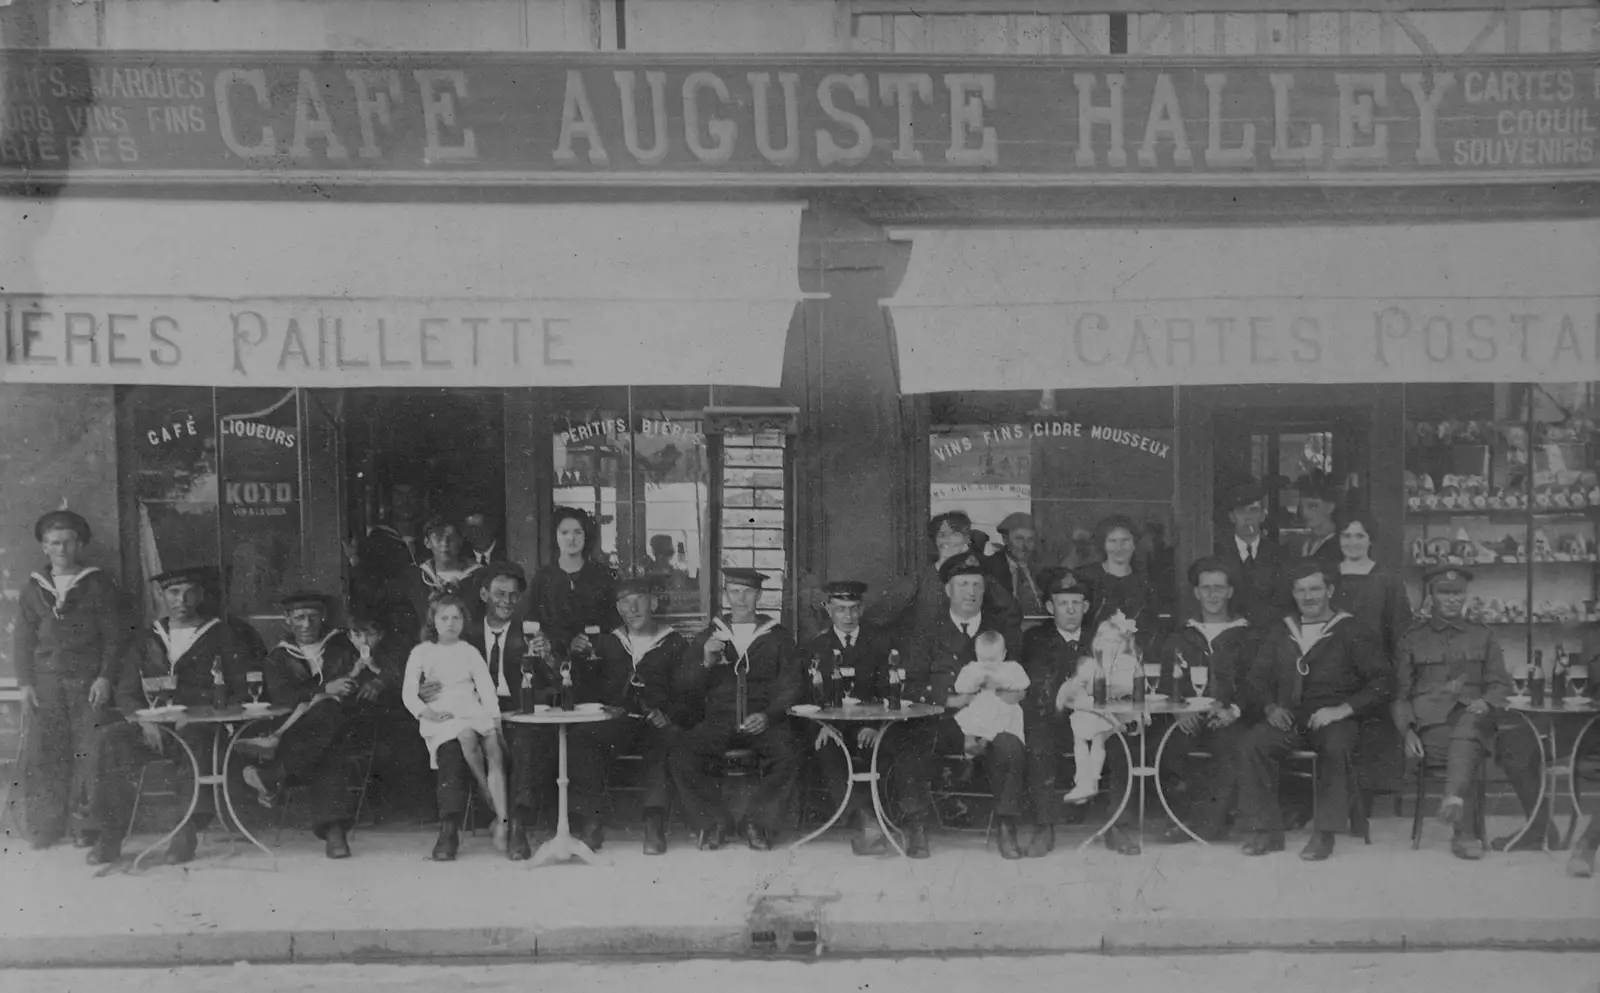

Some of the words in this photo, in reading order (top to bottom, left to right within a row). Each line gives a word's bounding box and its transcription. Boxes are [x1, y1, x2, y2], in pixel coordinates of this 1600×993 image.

[92, 68, 206, 100] MARQUES
[1464, 70, 1576, 103] CARTES
[66, 104, 129, 134] VINS
[147, 104, 206, 134] FINS
[213, 67, 477, 164] CAFE
[552, 69, 999, 167] AUGUSTE
[1072, 72, 1457, 168] HALLEY
[1497, 107, 1598, 135] COQUIL
[1453, 137, 1595, 166] SOUVENIRS
[229, 309, 574, 376] PAILLETTE
[1072, 311, 1322, 368] CARTES
[147, 414, 197, 446] CAFÉ
[219, 419, 297, 449] LIQUEURS
[933, 435, 973, 462] VINS
[983, 424, 1024, 446] FINS
[1033, 421, 1082, 438] CIDRE
[1091, 424, 1170, 459] MOUSSEUX
